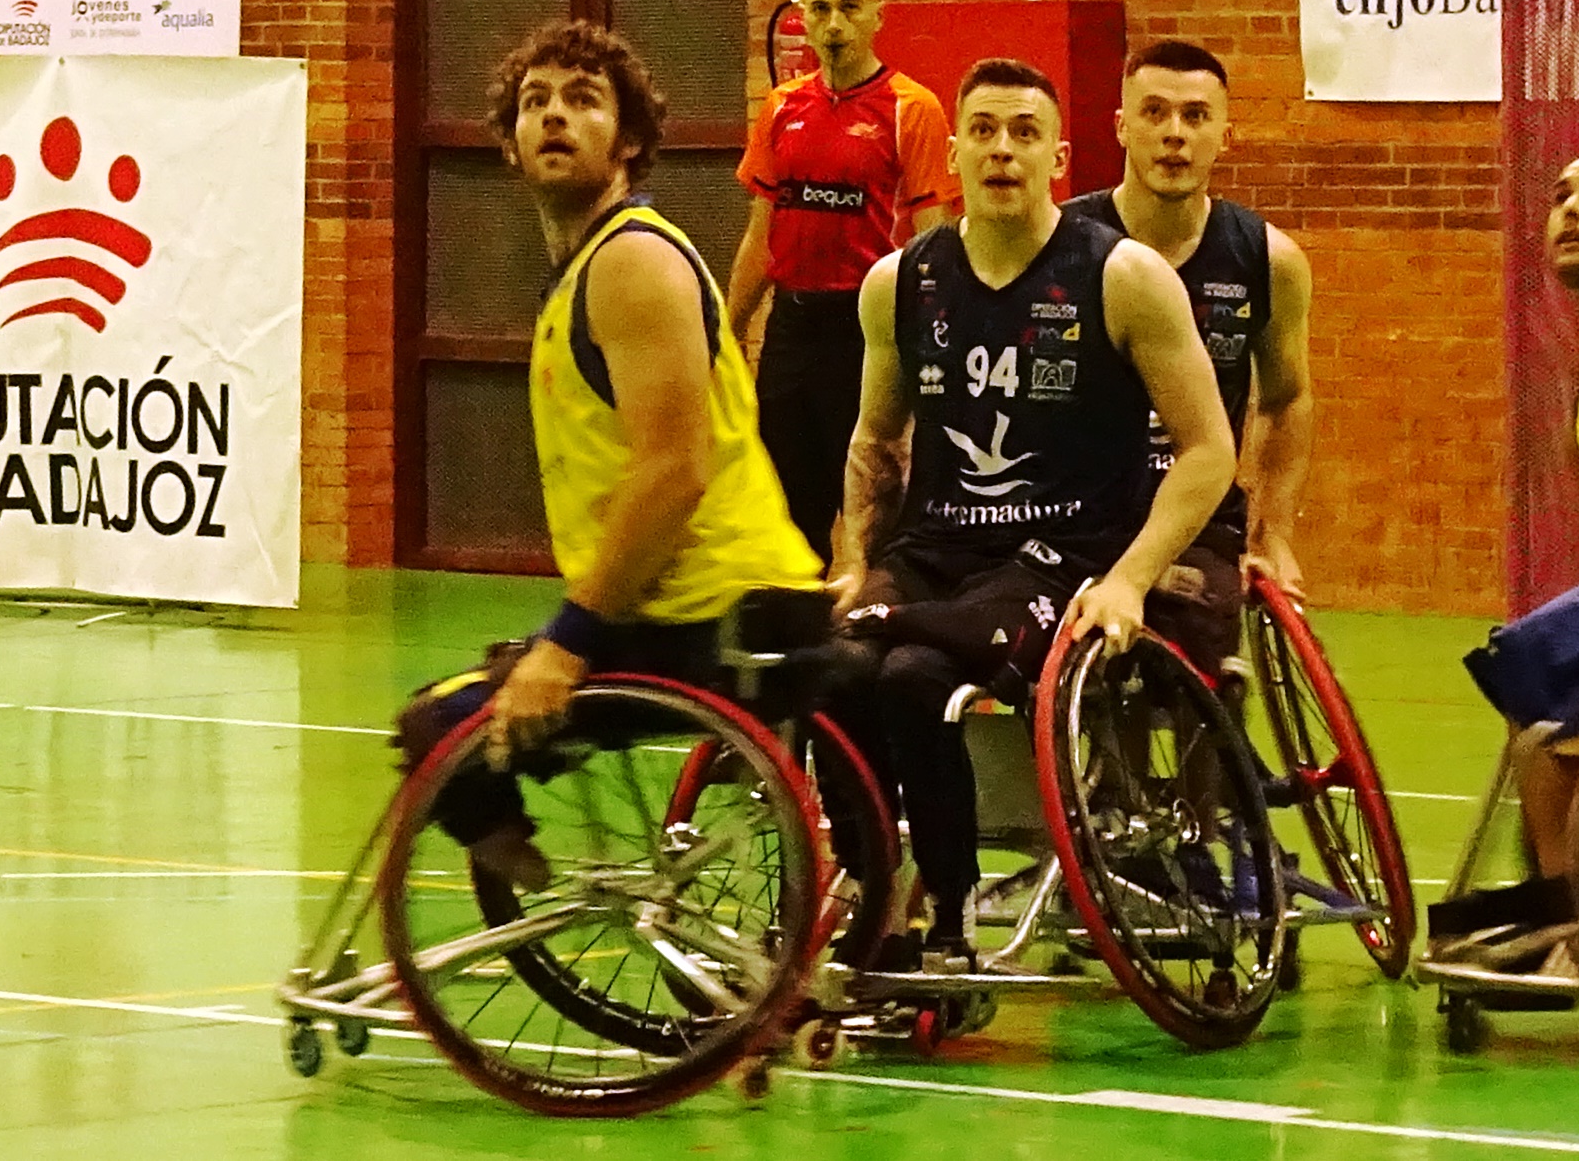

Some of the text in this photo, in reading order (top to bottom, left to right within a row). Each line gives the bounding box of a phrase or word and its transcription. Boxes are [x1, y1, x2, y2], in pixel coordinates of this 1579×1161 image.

[161, 8, 215, 32] aqualia
[803, 185, 863, 207] bequal
[965, 346, 1019, 398] 94
